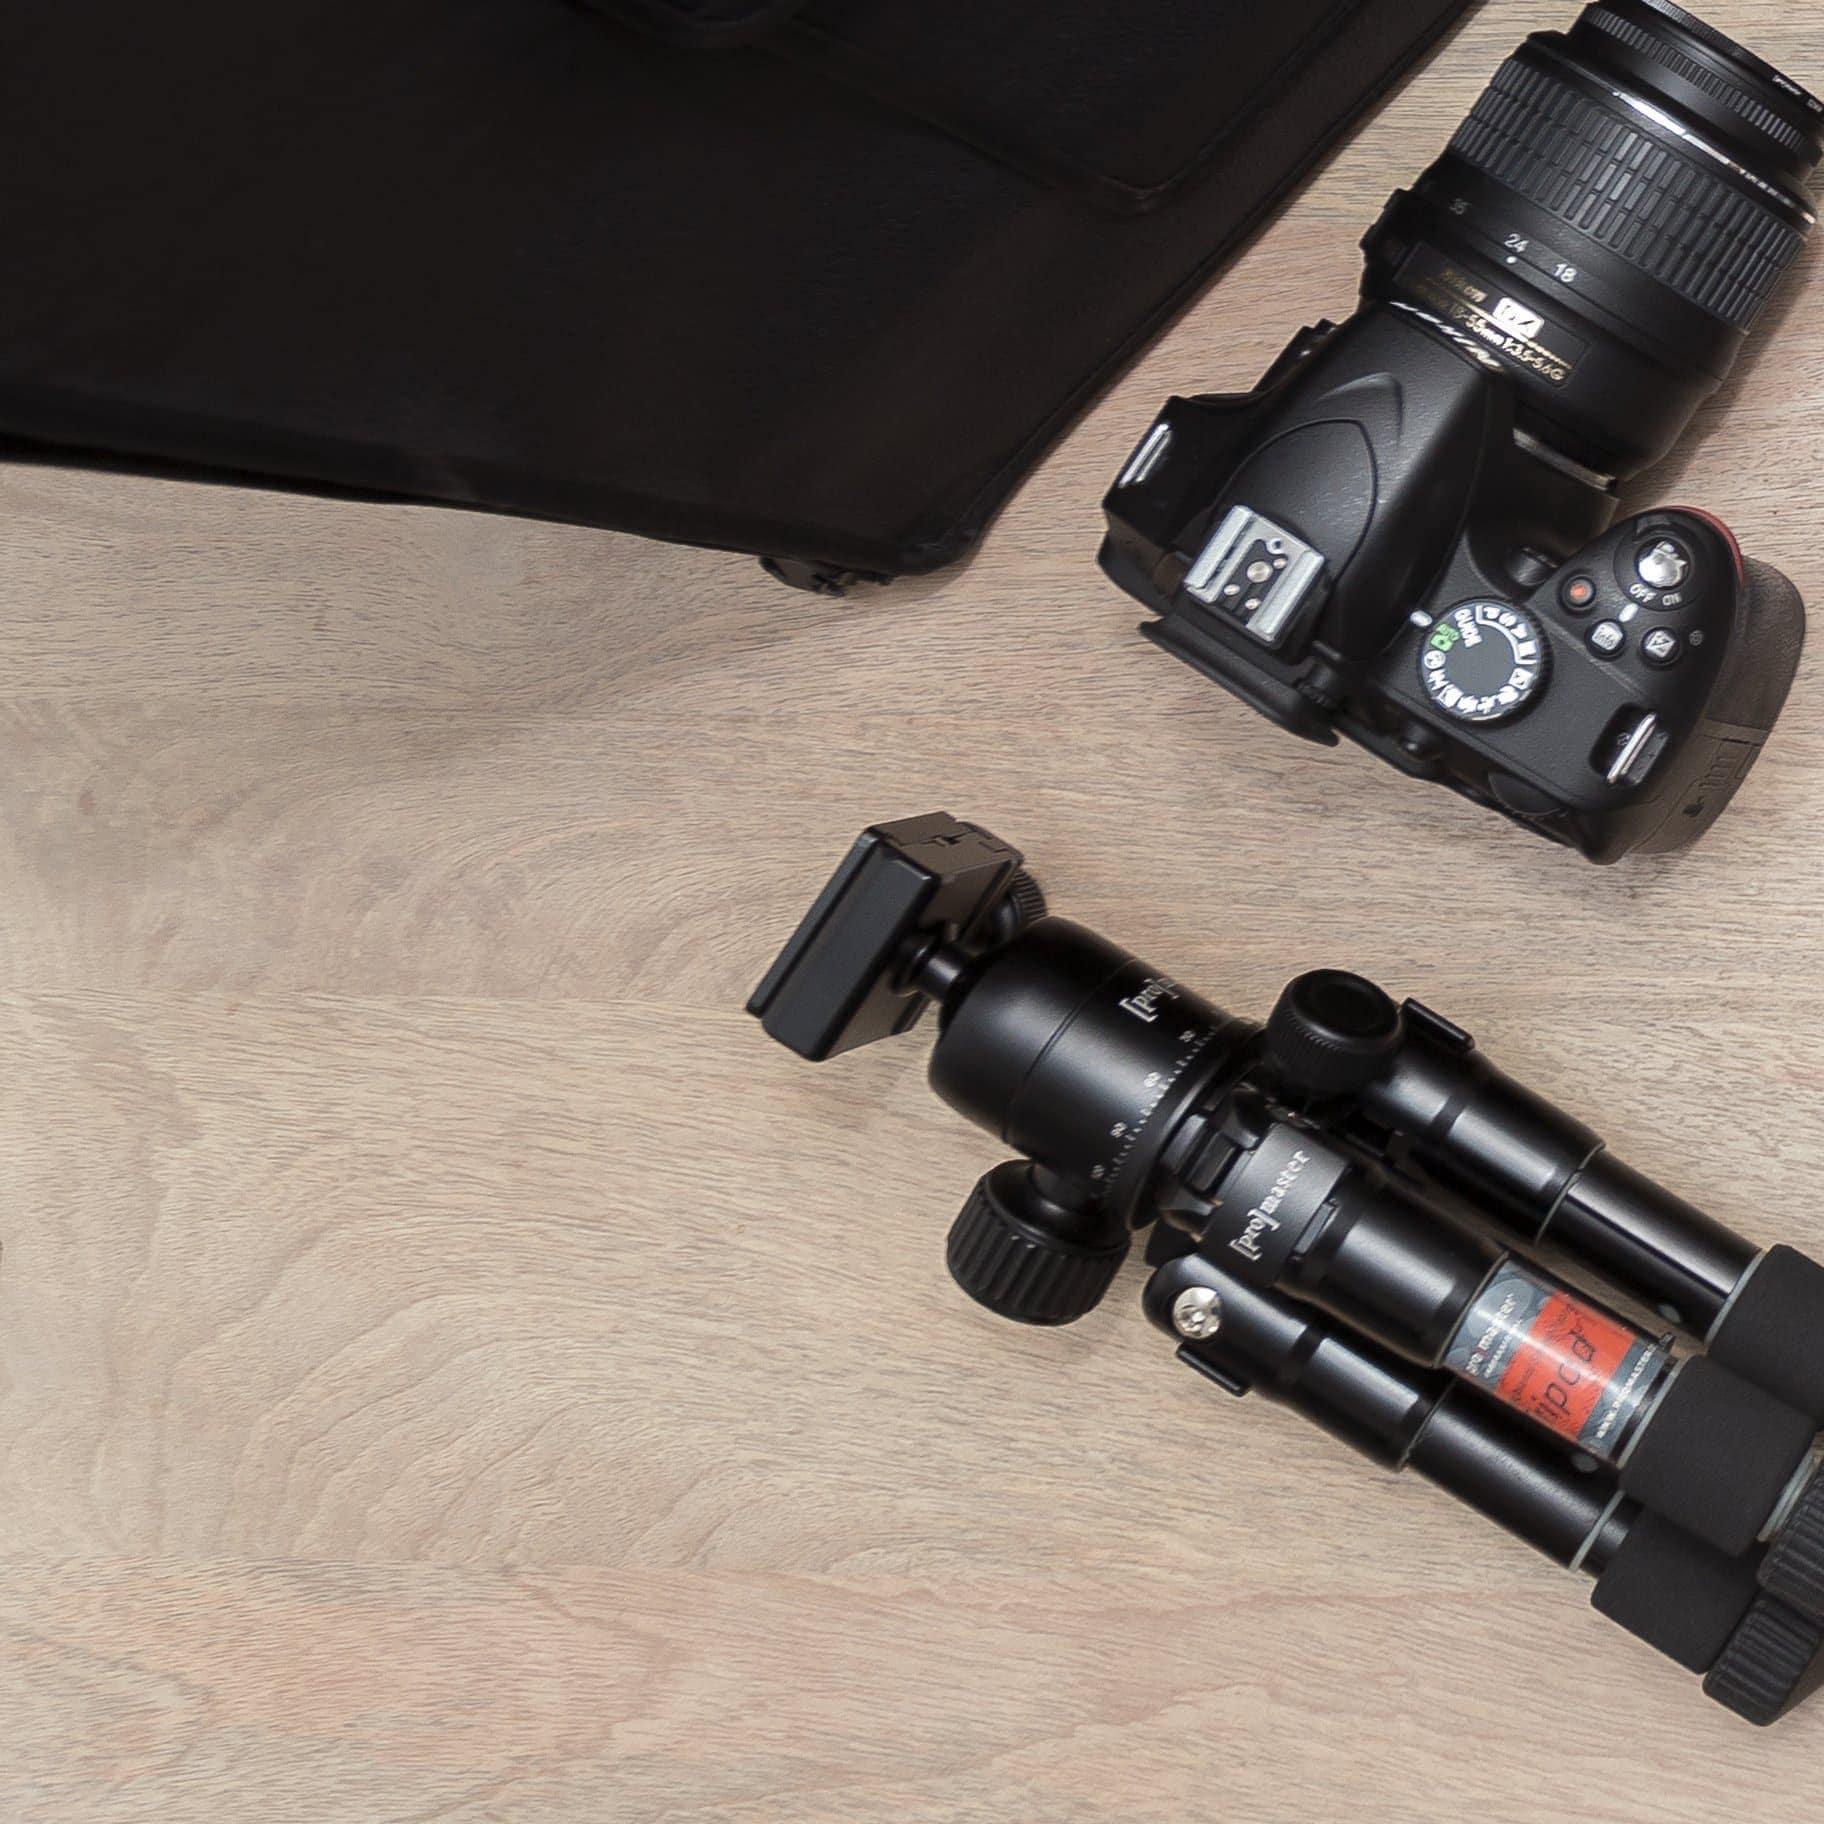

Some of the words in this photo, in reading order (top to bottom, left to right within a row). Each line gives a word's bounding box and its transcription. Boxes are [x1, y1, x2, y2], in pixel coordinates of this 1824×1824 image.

[1503, 232, 1529, 253] 24
[1553, 262, 1578, 283] 18
[1629, 583, 1657, 603] OFF
[1229, 1150, 1311, 1262] [pro]master
